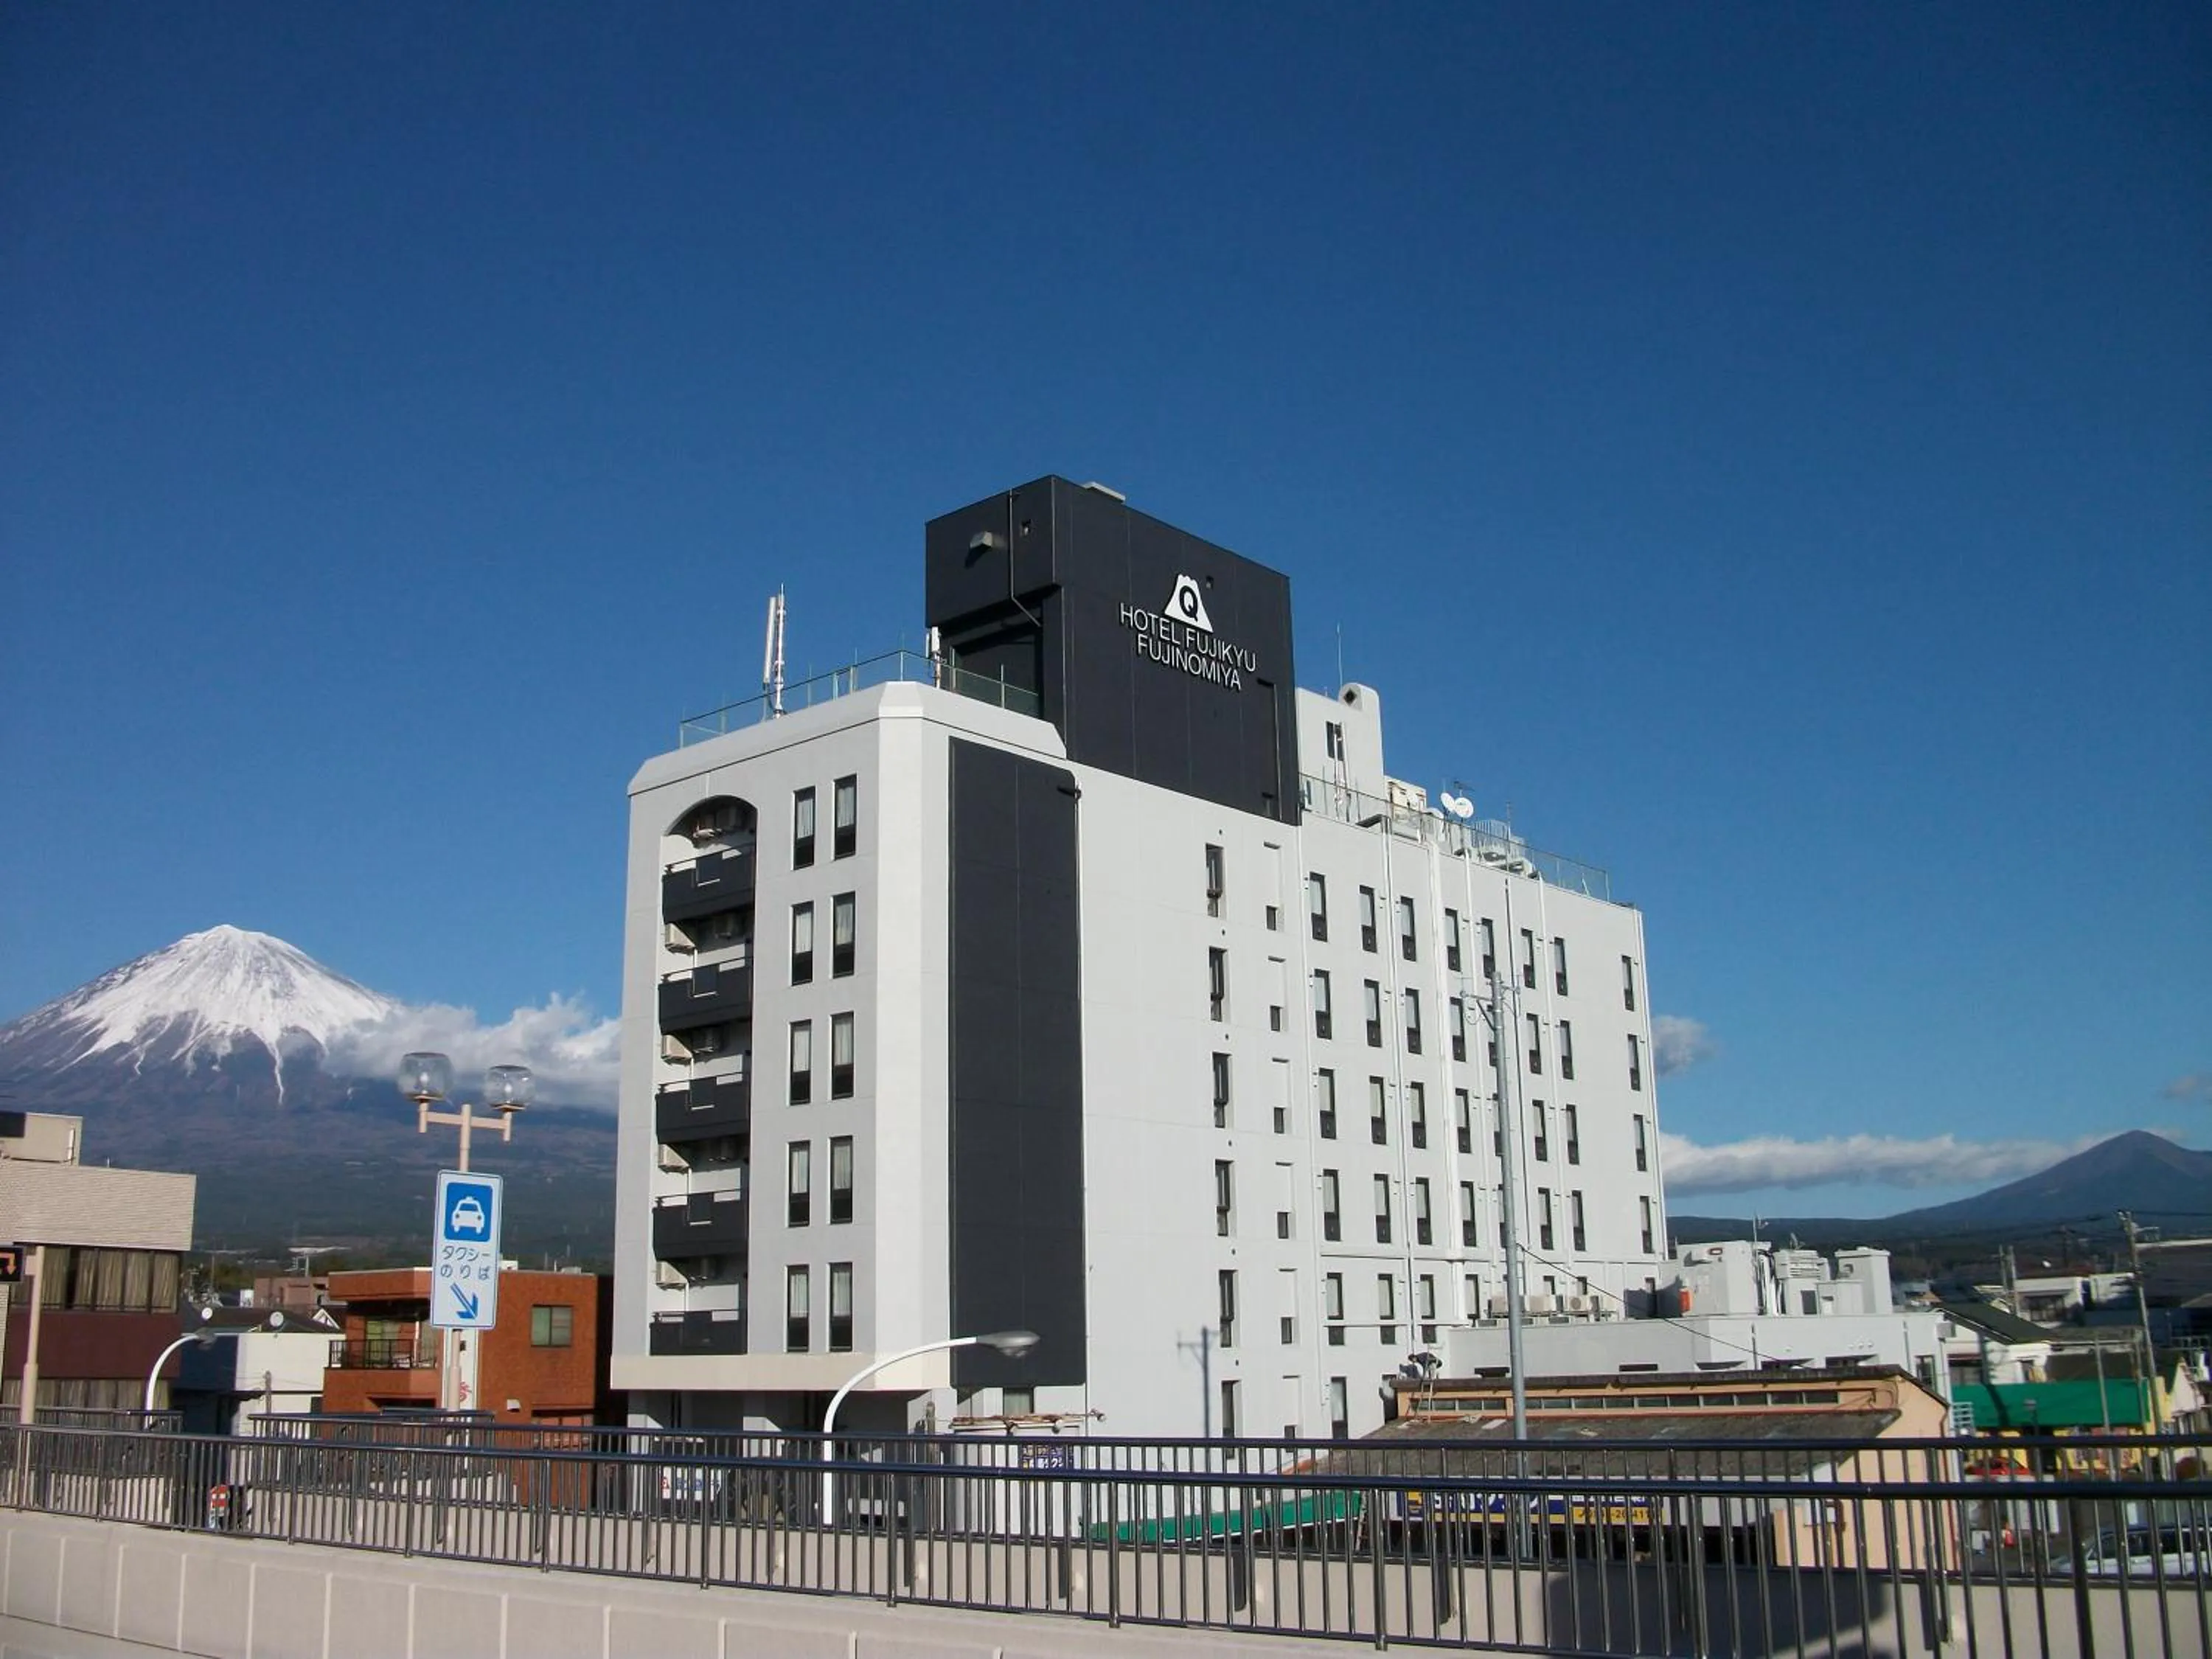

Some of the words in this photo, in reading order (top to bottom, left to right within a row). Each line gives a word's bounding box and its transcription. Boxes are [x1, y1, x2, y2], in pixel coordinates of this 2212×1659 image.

[1180, 585, 1198, 622] Q
[1119, 602, 1180, 645] HOTEL
[1186, 627, 1256, 672] FUJIKYU
[1137, 633, 1242, 691] FUJINOMIYA
[442, 1245, 490, 1262] タクシー
[440, 1264, 490, 1281] のりば
